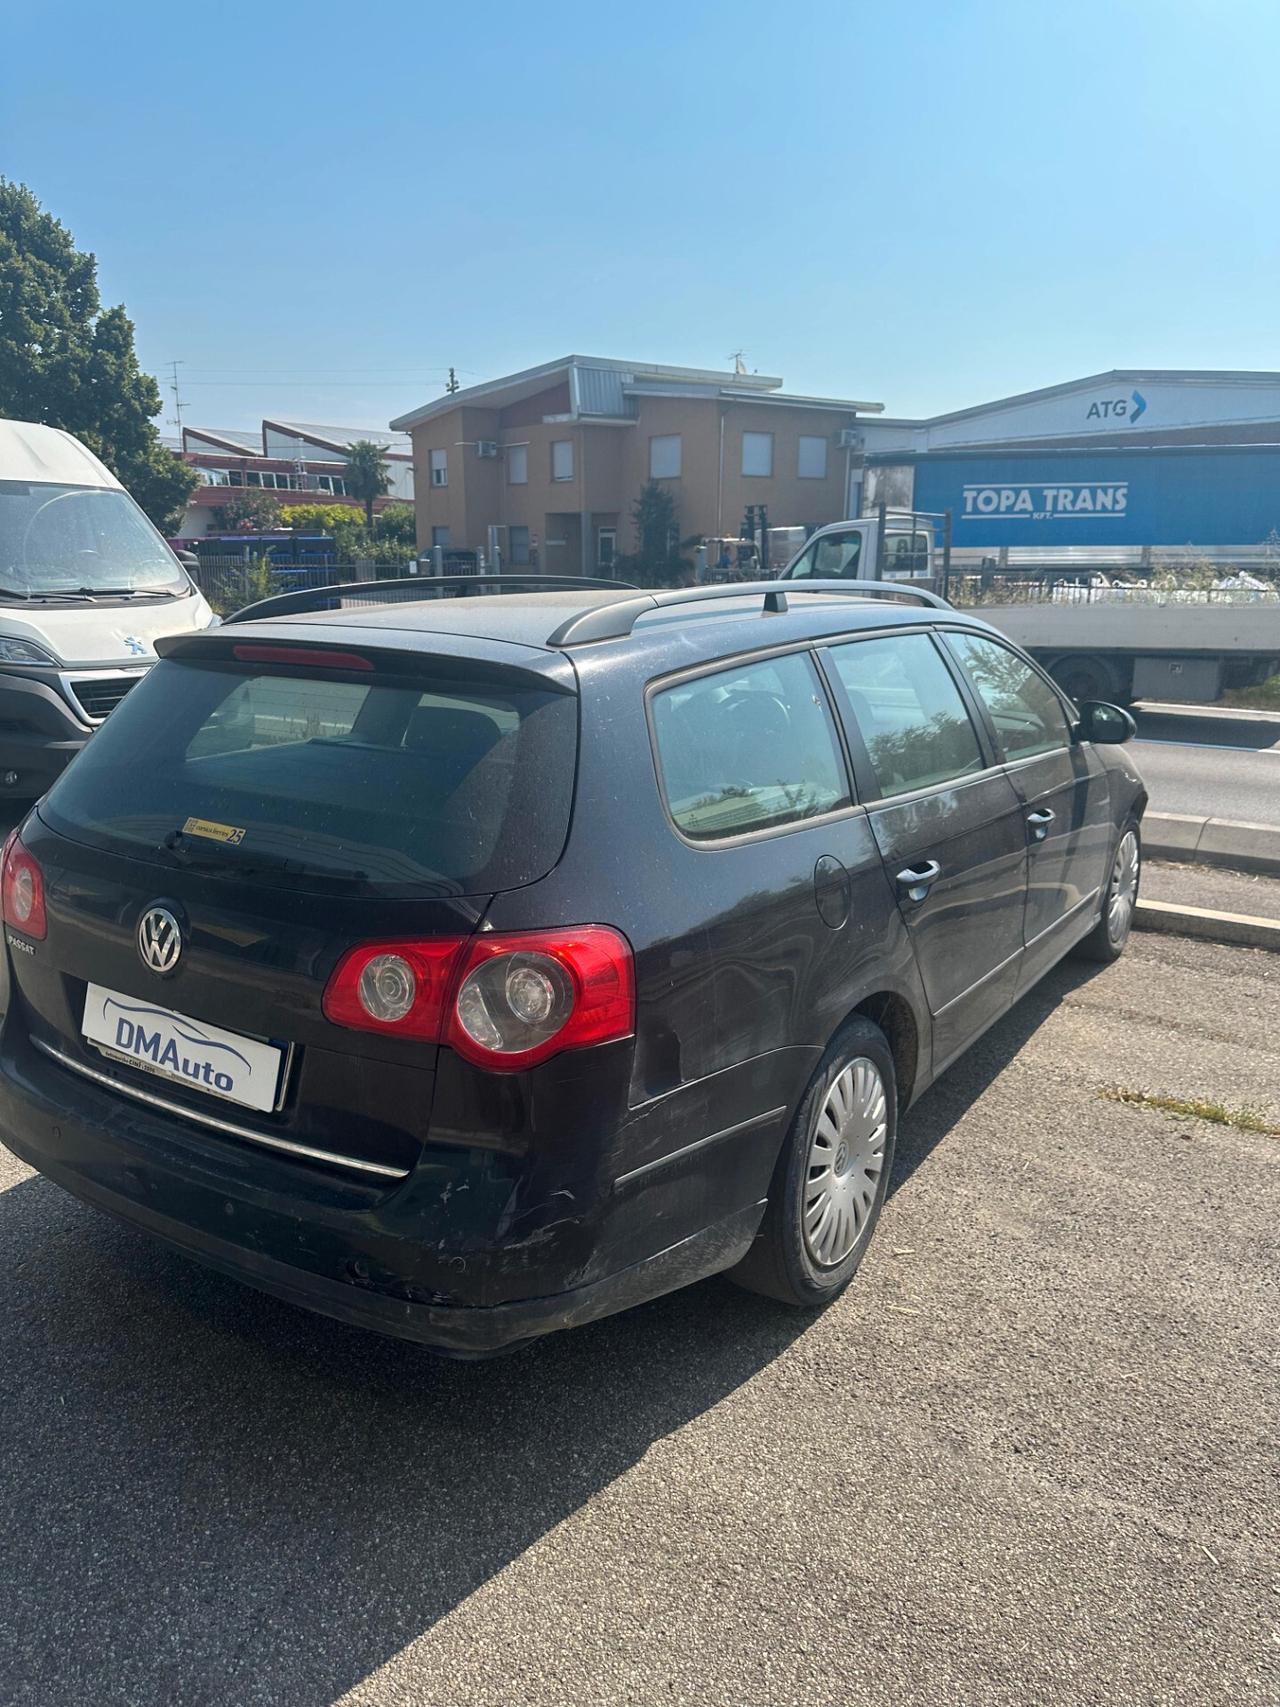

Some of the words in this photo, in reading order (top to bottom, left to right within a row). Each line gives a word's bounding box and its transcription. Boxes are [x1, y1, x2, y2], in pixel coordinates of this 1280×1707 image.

[1086, 399, 1127, 419] ATG
[963, 489, 1034, 512] TOPA
[1043, 488, 1128, 511] TRANS
[226, 828, 244, 843] 25
[115, 1016, 234, 1092] DMAuto
